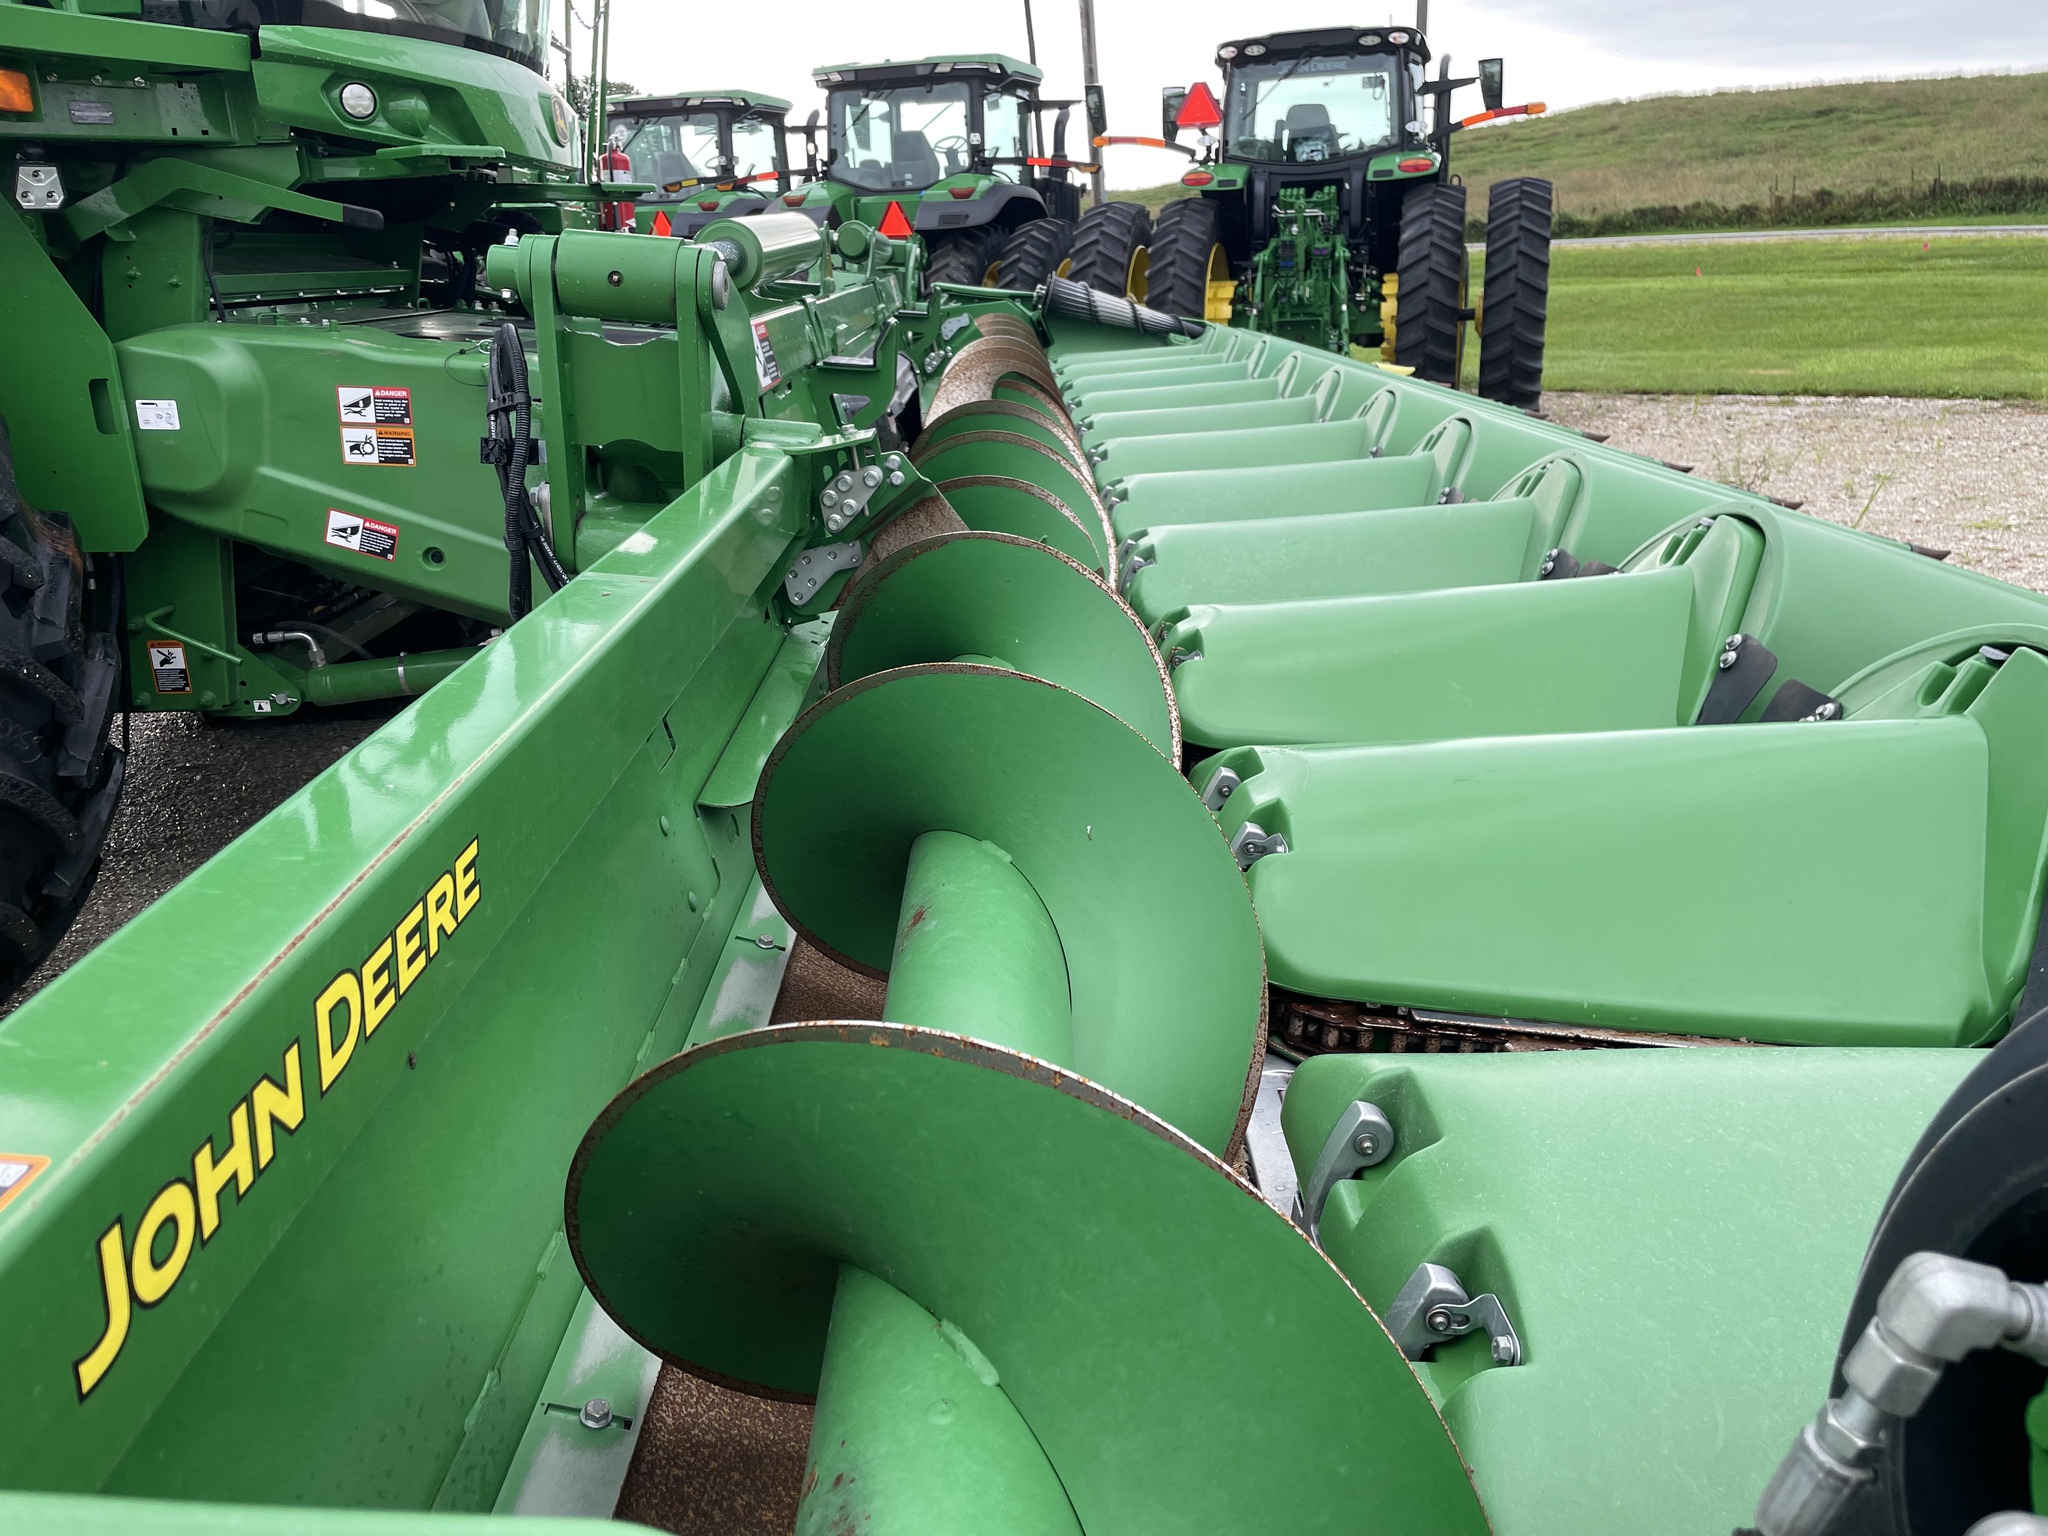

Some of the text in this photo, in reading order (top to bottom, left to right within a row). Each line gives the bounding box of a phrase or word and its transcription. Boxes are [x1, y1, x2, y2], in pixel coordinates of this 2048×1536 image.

[370, 522, 397, 534] DANGER
[73, 835, 481, 1403] JOHN DEERE
